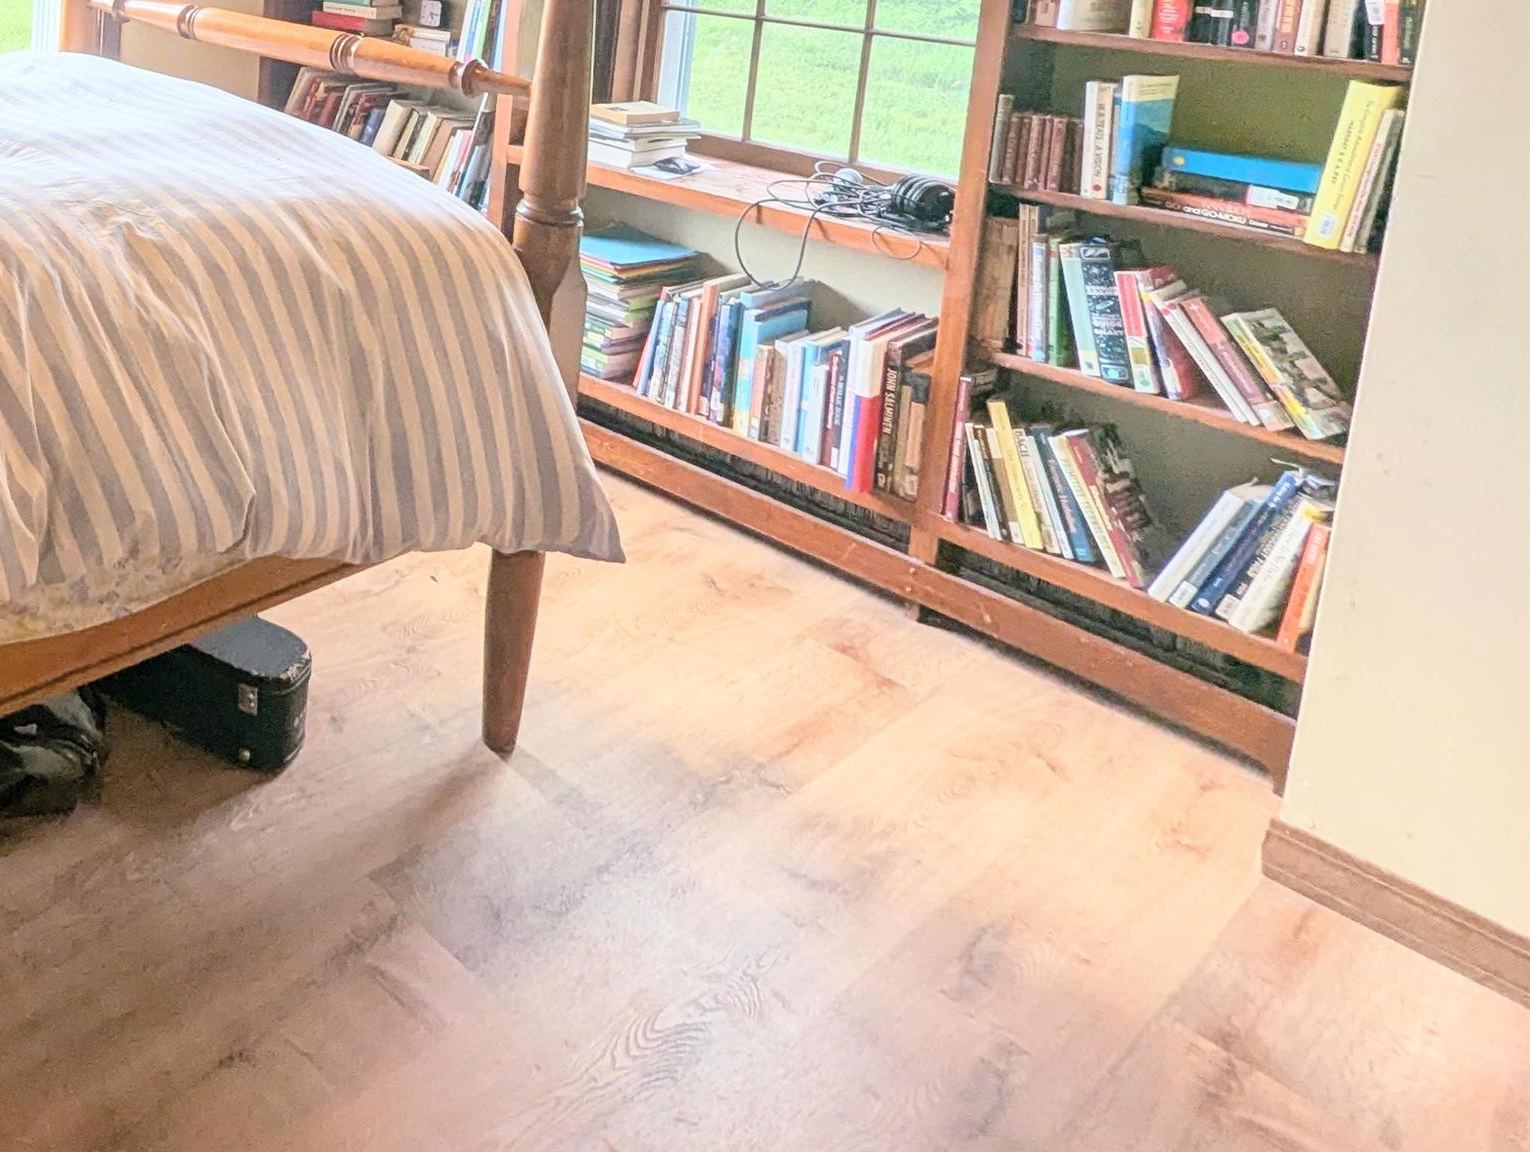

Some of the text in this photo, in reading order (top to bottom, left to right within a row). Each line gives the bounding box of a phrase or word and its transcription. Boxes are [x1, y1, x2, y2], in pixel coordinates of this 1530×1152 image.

[1182, 205, 1201, 215] and
[884, 368, 897, 391] JOHN
[880, 391, 895, 435] SALMINEN
